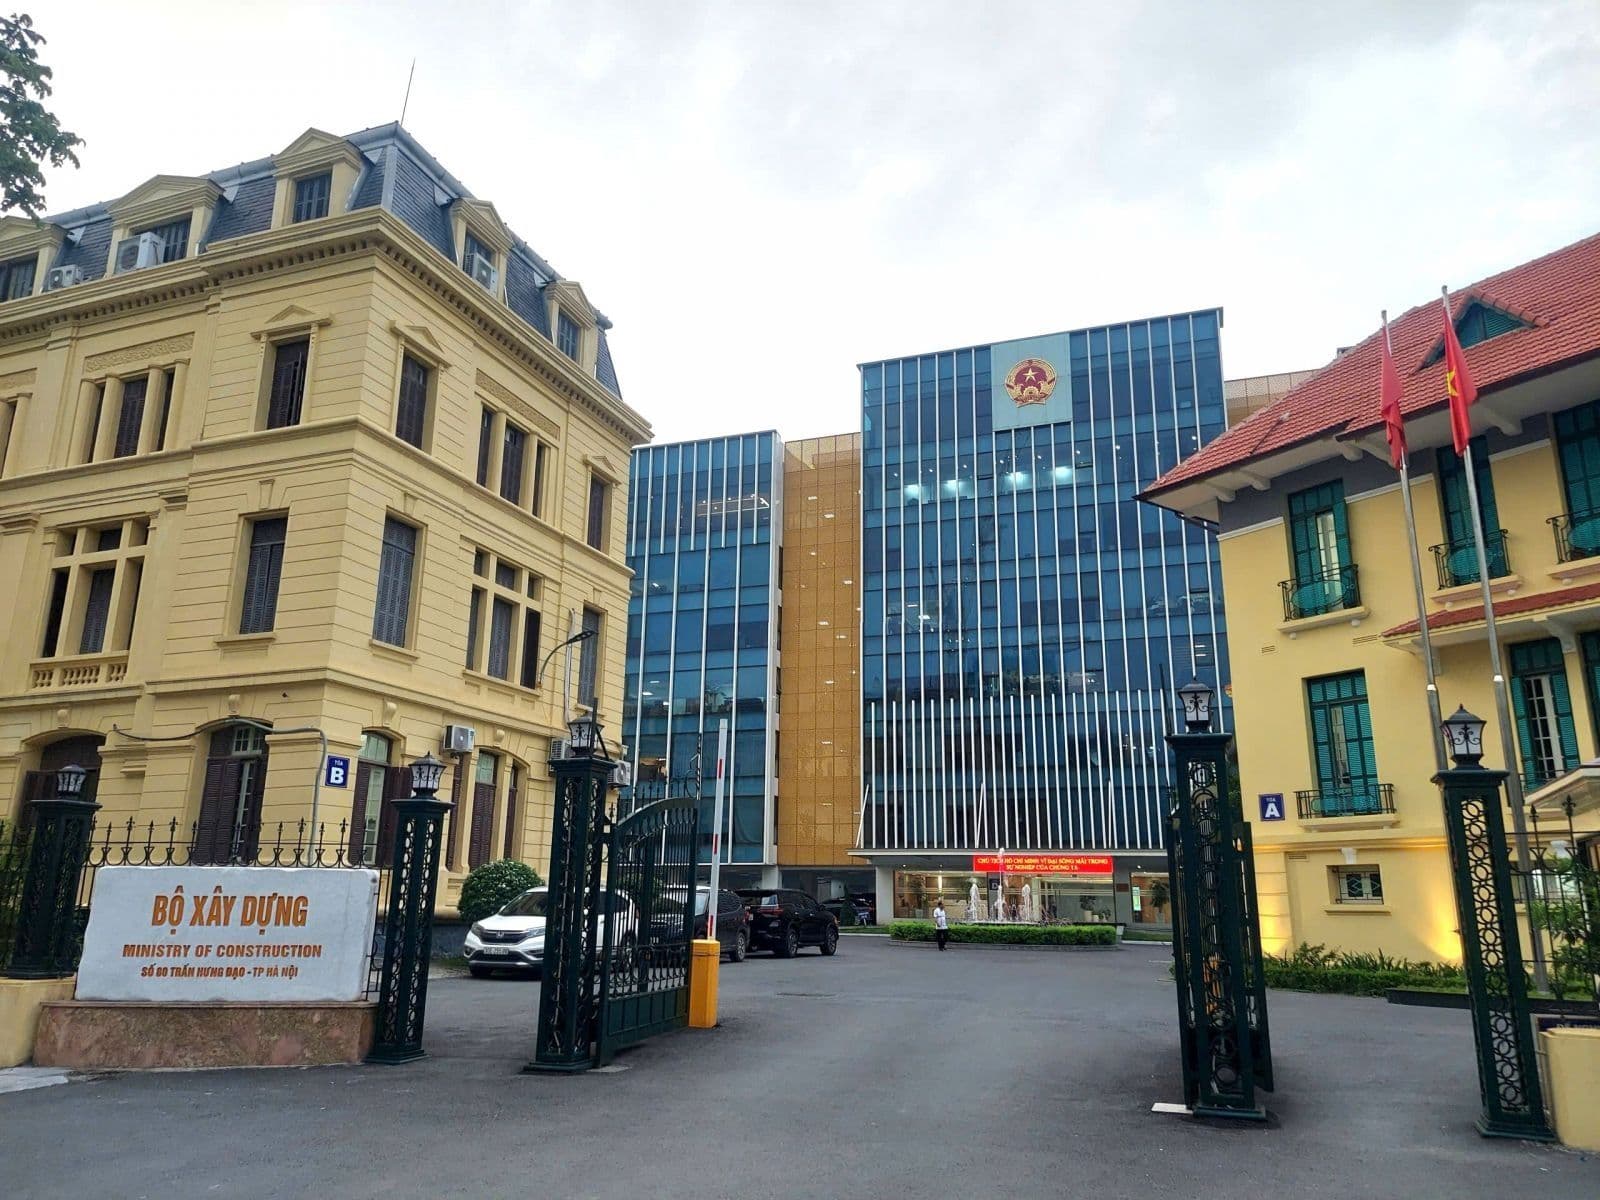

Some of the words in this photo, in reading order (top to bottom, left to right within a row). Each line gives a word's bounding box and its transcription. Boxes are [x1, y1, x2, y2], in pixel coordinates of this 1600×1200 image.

[330, 766, 344, 784] B
[1265, 802, 1280, 818] A
[152, 885, 184, 935] BỘ
[189, 885, 236, 927] XÂY
[241, 892, 308, 935] DỰNG
[122, 944, 191, 958] MINISTRY
[195, 944, 213, 958] OF
[216, 944, 322, 958] CONSTRUCTION
[196, 966, 224, 977] HƯNG
[281, 965, 298, 980] NỘI
